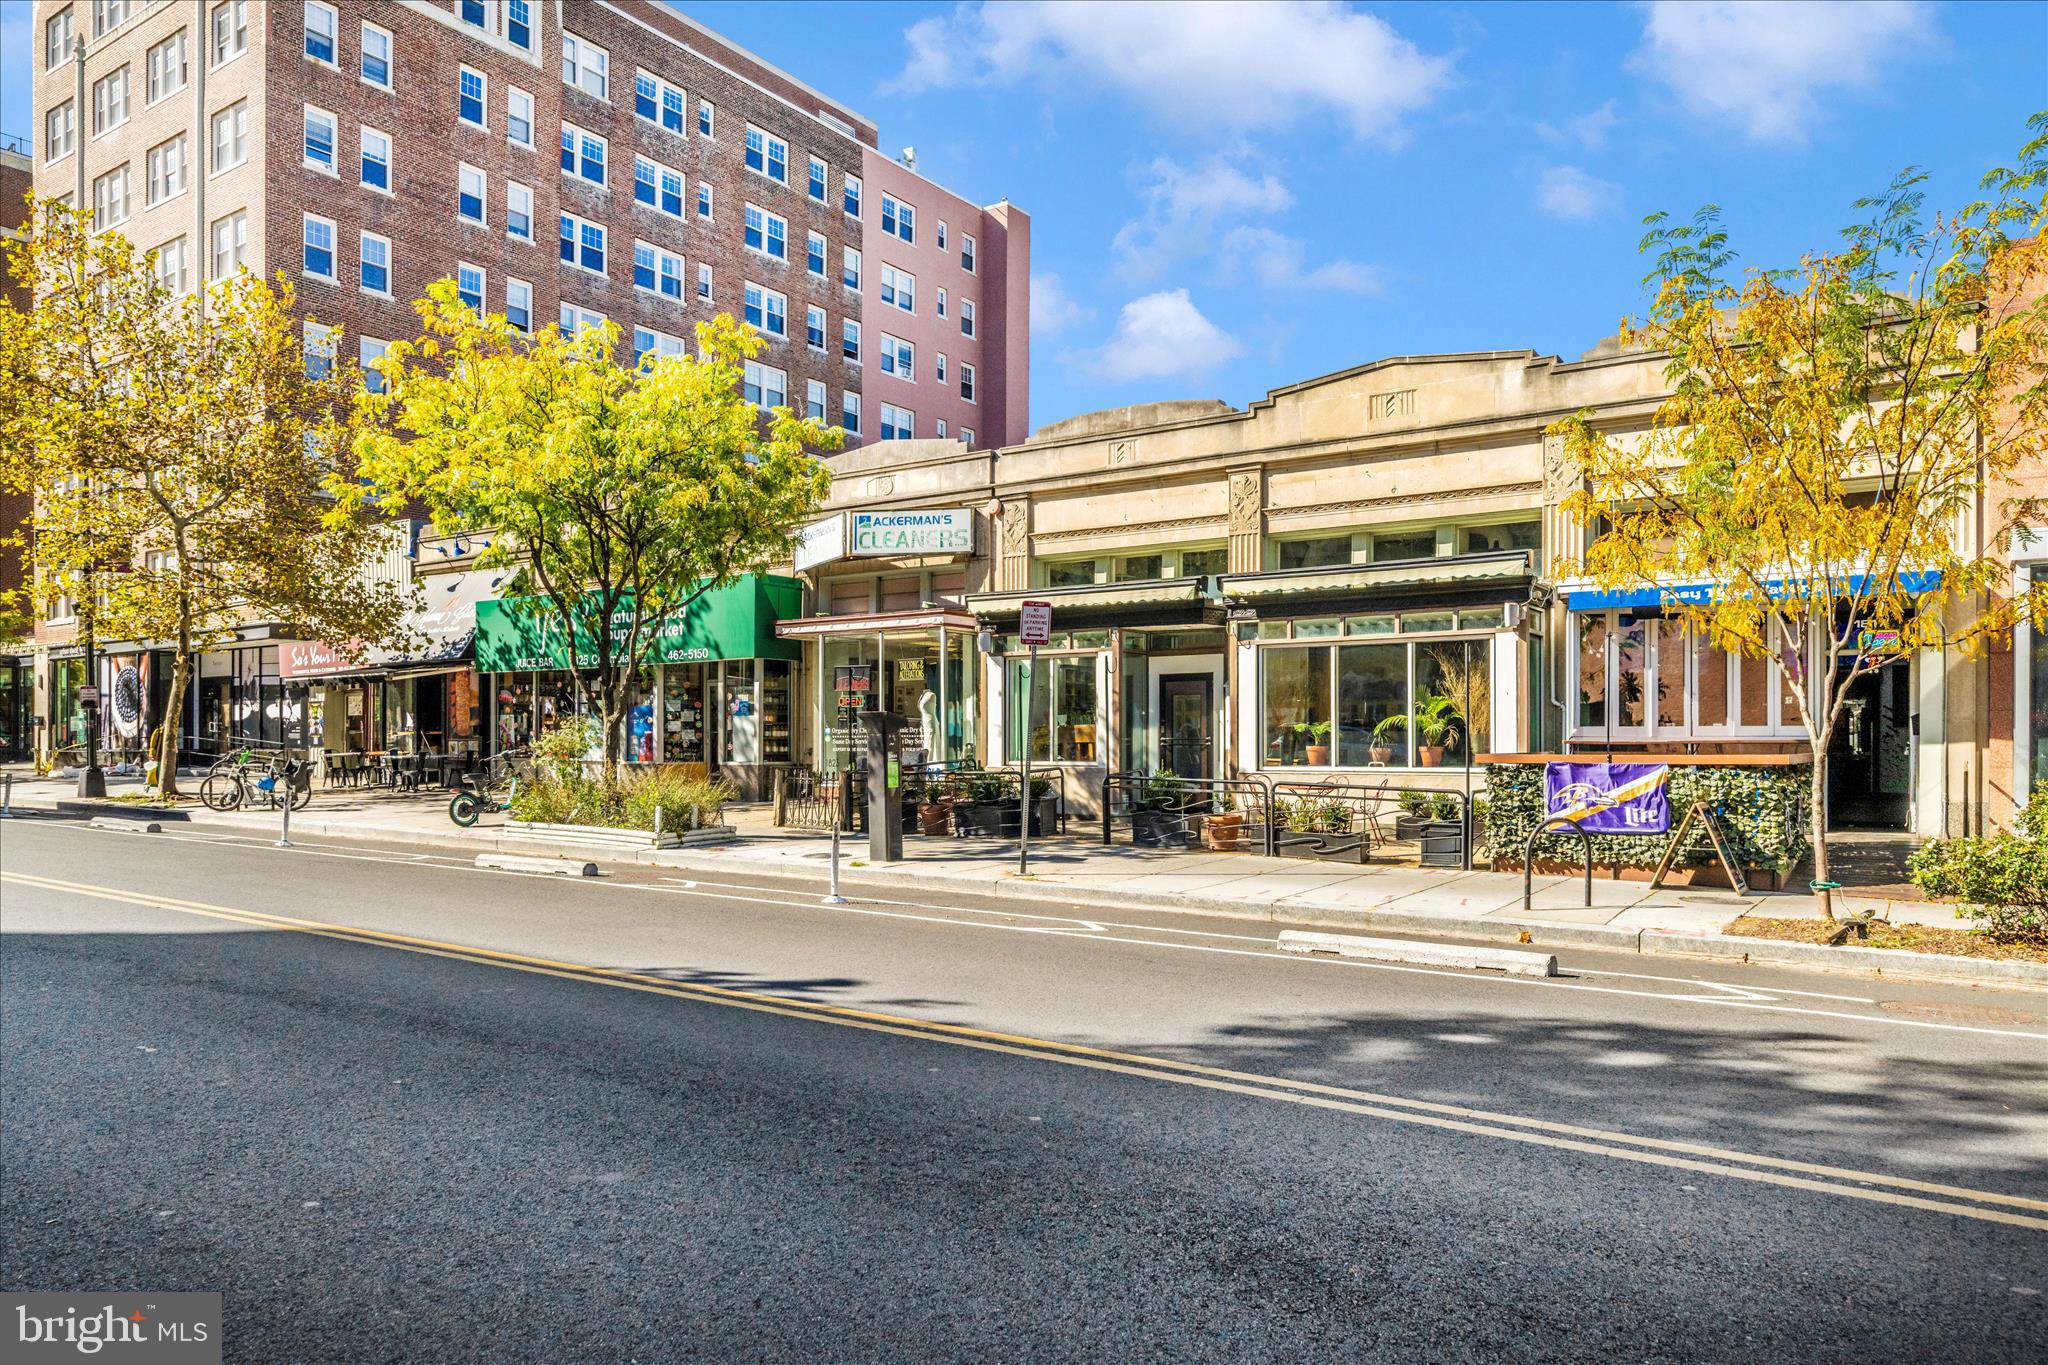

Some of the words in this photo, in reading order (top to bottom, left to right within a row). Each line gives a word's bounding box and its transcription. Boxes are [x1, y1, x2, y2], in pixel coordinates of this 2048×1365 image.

[873, 514, 952, 527] ACKERMAN'S
[858, 528, 968, 549] CLEANERS
[291, 646, 308, 667] So's
[310, 646, 331, 665] Your
[667, 648, 709, 660] 462-5150
[515, 658, 536, 668] JUICE
[538, 657, 554, 667] BAR
[839, 697, 862, 706] OPEN
[1624, 806, 1659, 827] Lite
